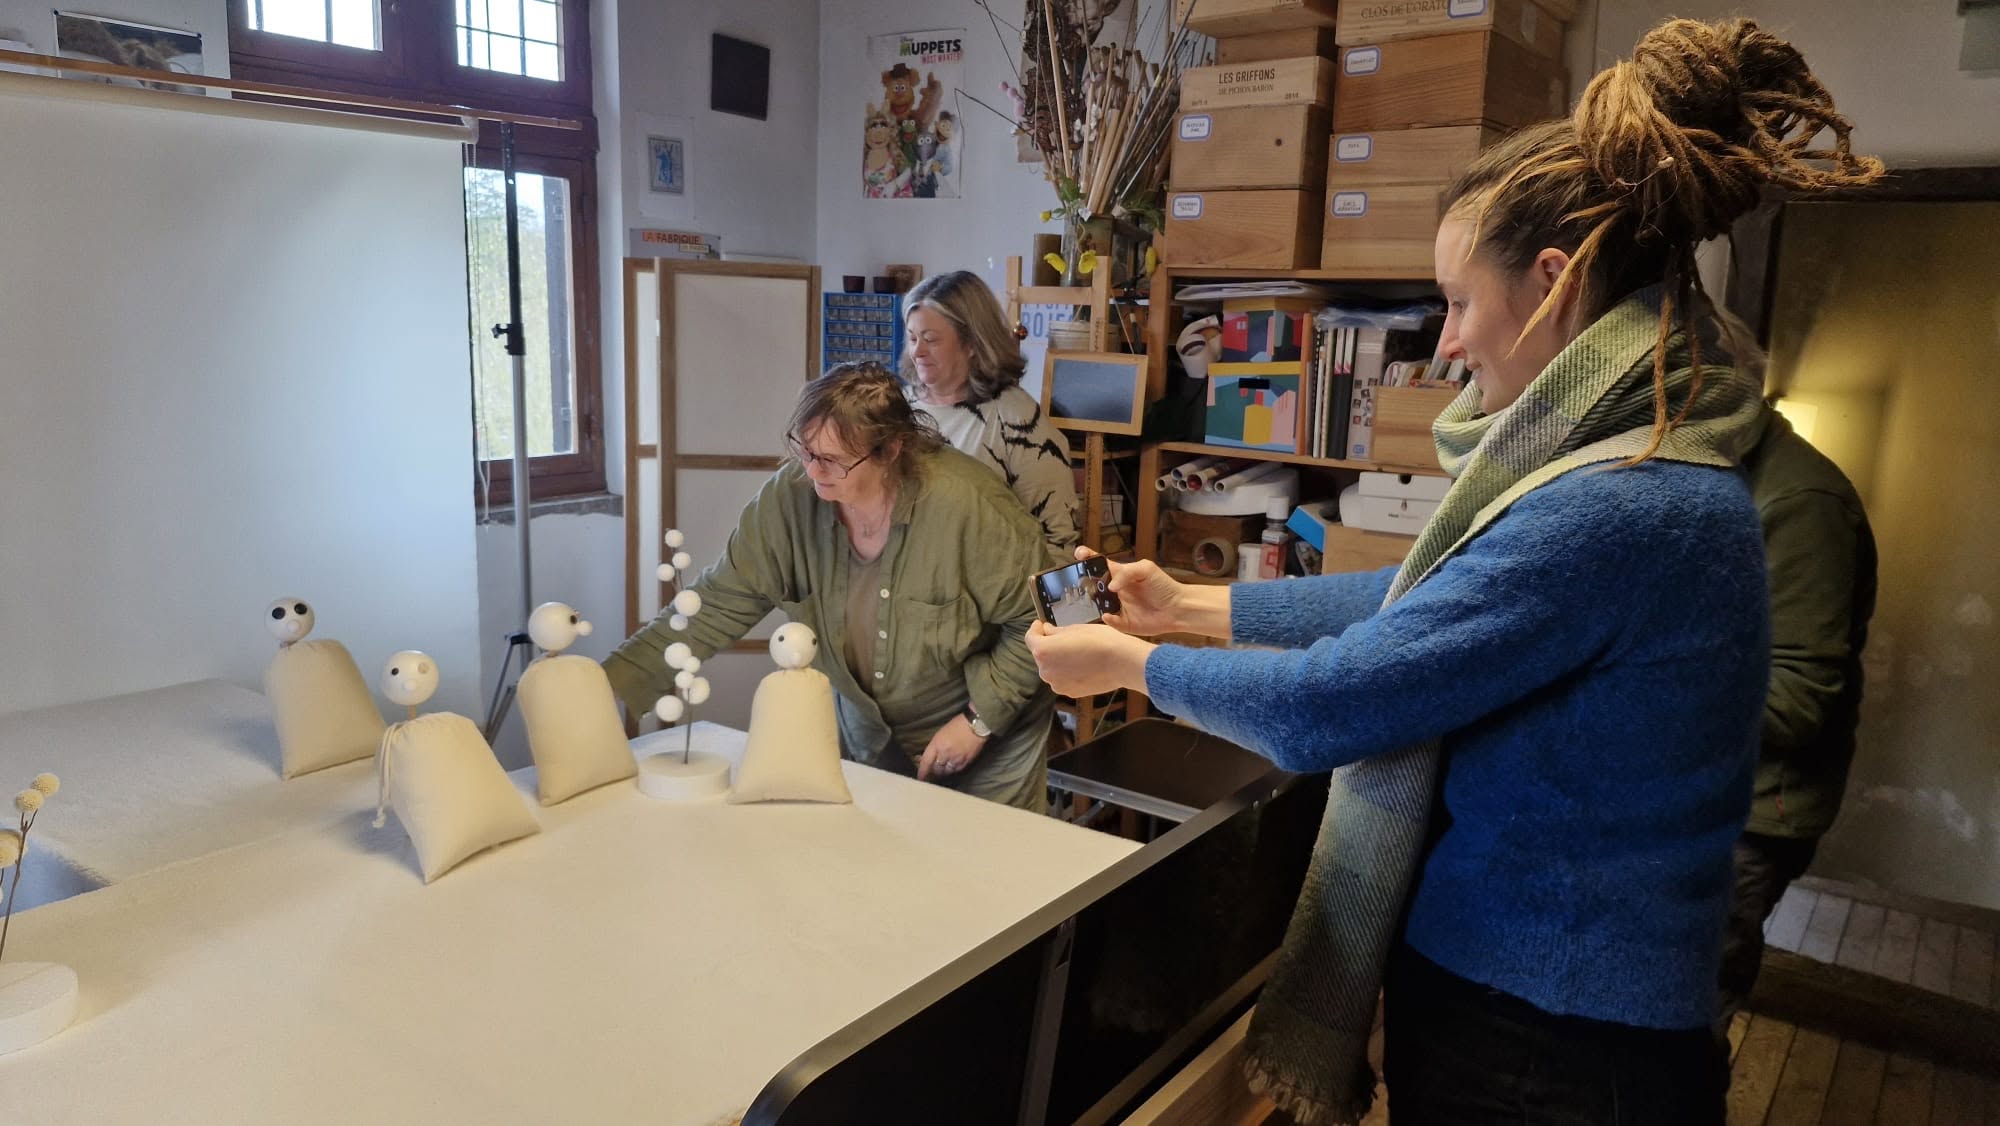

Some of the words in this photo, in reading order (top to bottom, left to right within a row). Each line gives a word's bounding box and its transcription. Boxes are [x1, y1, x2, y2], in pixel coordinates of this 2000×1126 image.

[1361, 6, 1388, 18] CLOS
[900, 39, 961, 56] MUPPETS
[1219, 72, 1233, 84] LES
[1236, 68, 1275, 82] GRIFFONS
[656, 232, 701, 245] FABRIQUE
